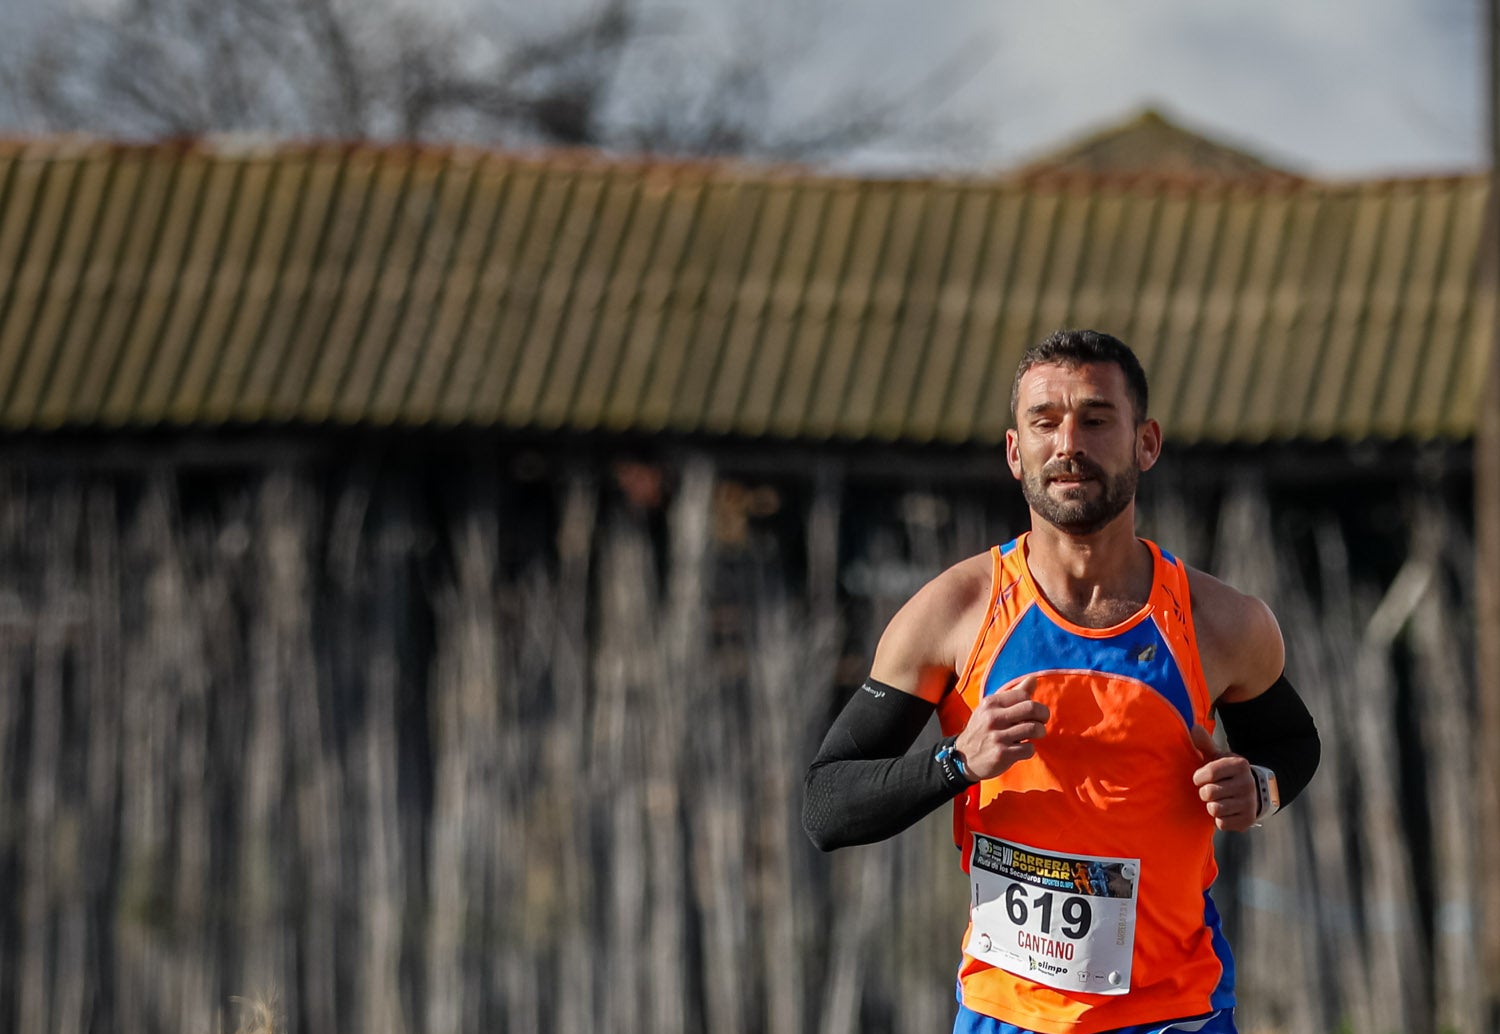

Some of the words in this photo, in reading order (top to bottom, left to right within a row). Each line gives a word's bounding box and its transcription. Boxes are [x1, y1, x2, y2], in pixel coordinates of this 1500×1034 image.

[977, 856, 991, 867] Ruta
[991, 861, 999, 870] de
[1000, 863, 1009, 873] los
[1002, 846, 1013, 867] VII
[1013, 850, 1070, 872] CARRERA
[1012, 860, 1070, 880] POPULAR
[1005, 882, 1092, 940] 619
[1018, 930, 1075, 961] CANTANO
[1038, 961, 1068, 975] olimpo
